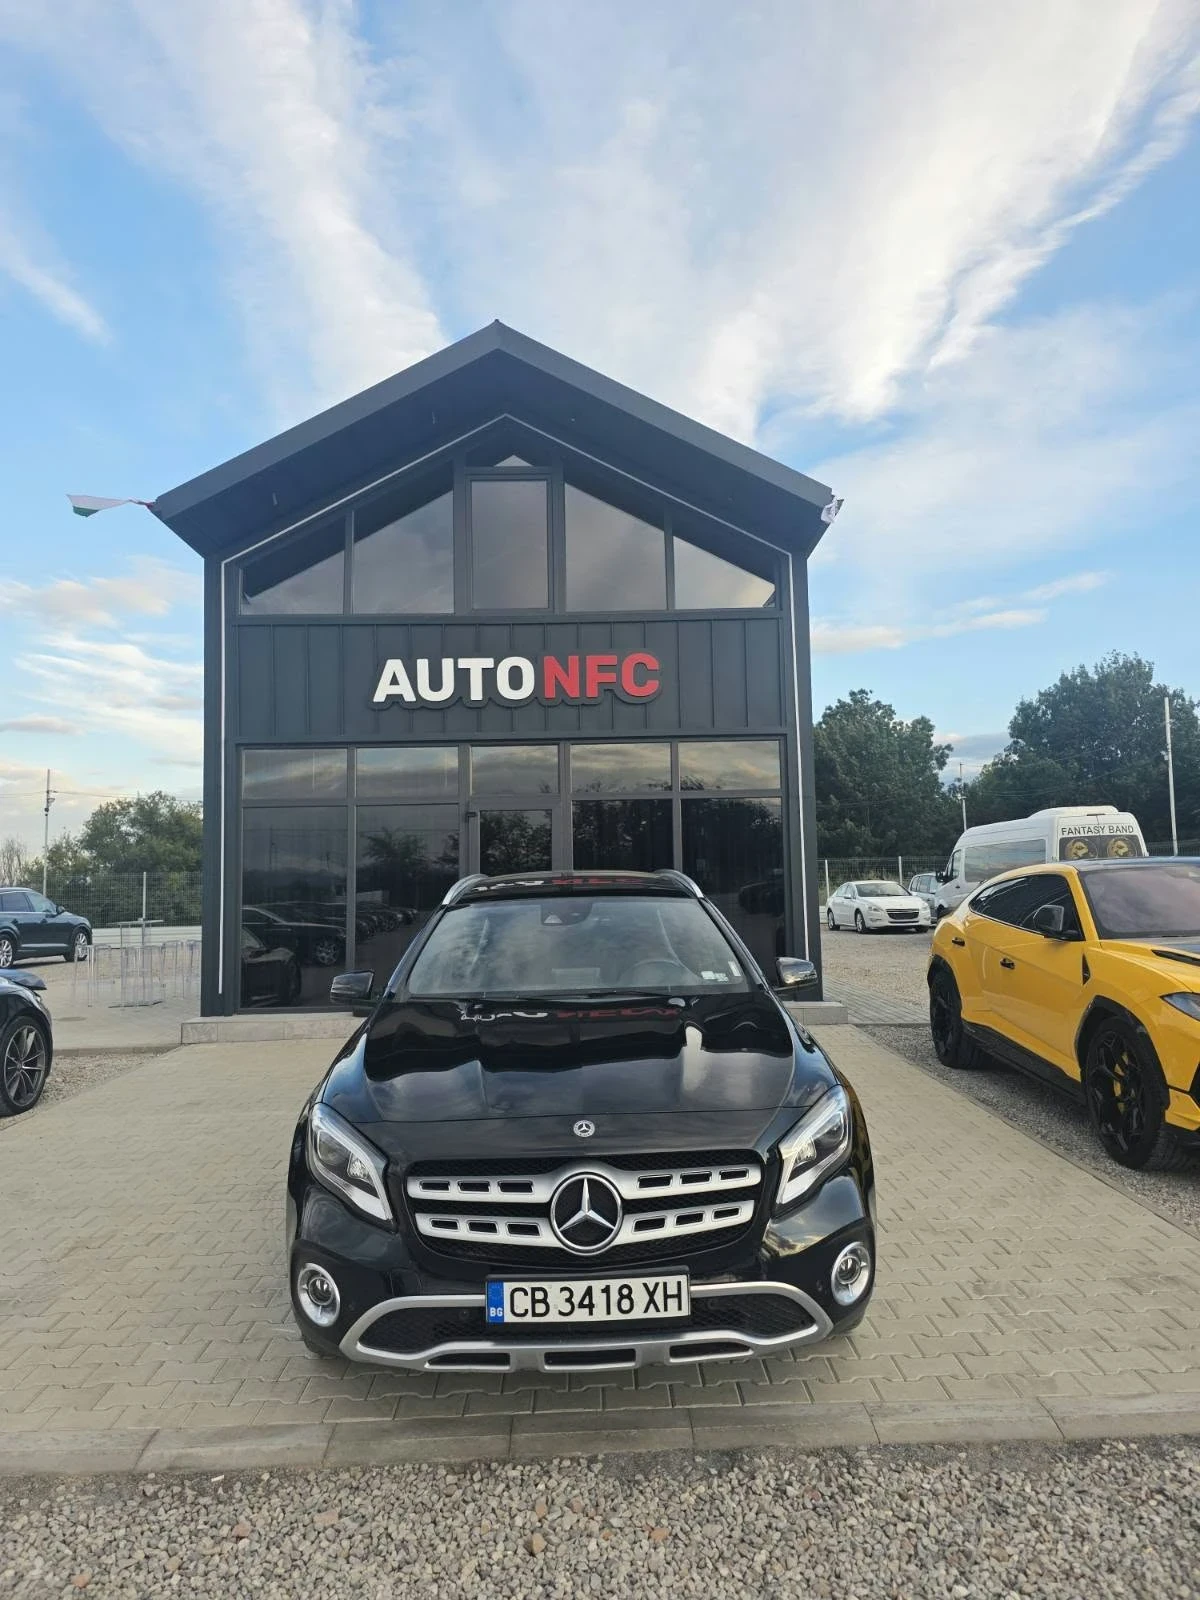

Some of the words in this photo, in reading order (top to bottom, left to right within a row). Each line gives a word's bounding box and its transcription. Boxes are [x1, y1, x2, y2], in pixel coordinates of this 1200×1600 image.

[373, 656, 535, 702] AUTO
[543, 652, 660, 698] NFC
[1061, 826, 1106, 836] FANTASY
[1108, 825, 1134, 834] BAND
[489, 1307, 503, 1317] BG
